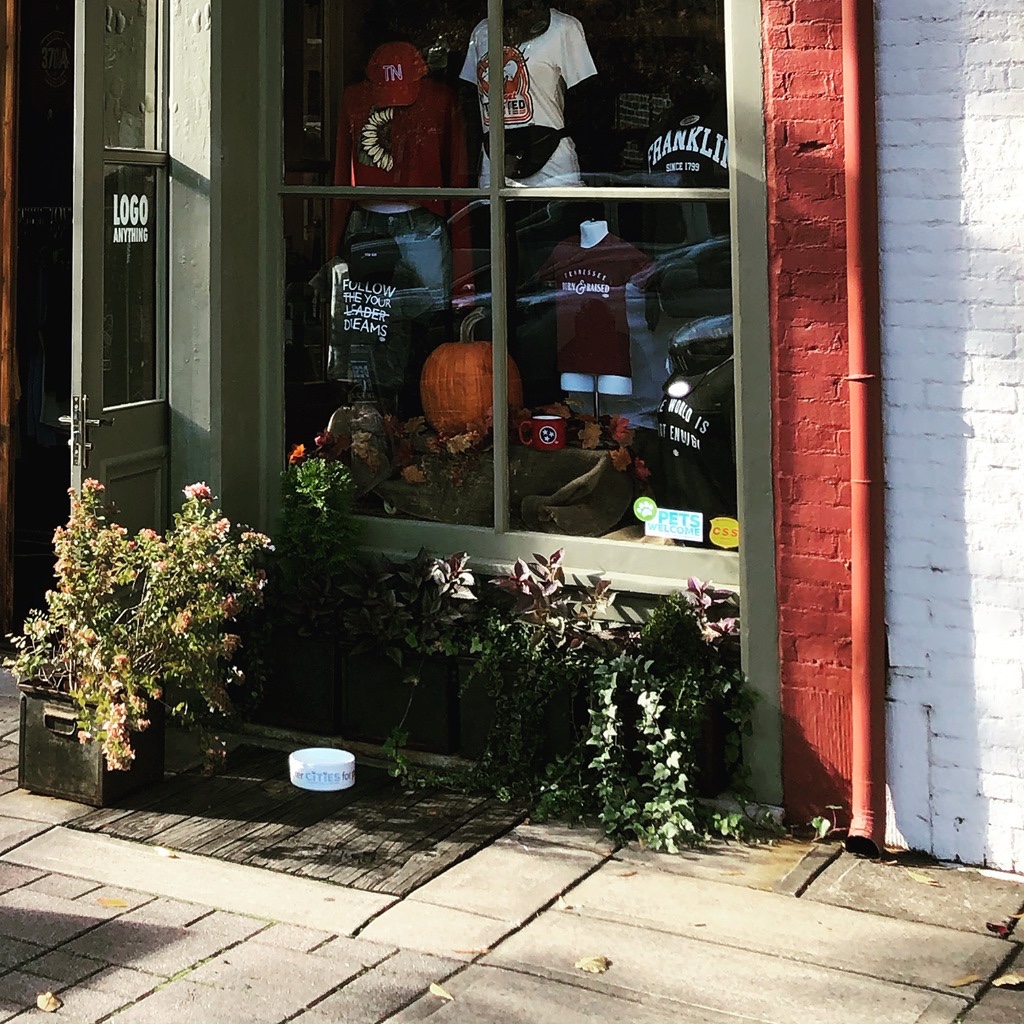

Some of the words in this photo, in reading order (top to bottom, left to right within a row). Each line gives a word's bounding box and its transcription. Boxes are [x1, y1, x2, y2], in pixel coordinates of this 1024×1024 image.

[382, 63, 403, 82] TN
[665, 162, 684, 173] SINCE
[684, 162, 700, 172] 1799
[113, 194, 149, 226] LOGO
[113, 227, 149, 244] ANYTHING
[586, 282, 610, 294] RAISED
[363, 293, 392, 309] YOUR
[343, 317, 389, 337] DEAMS
[694, 416, 710, 434] IS
[658, 511, 700, 528] PETS
[648, 523, 700, 537] WELCOME
